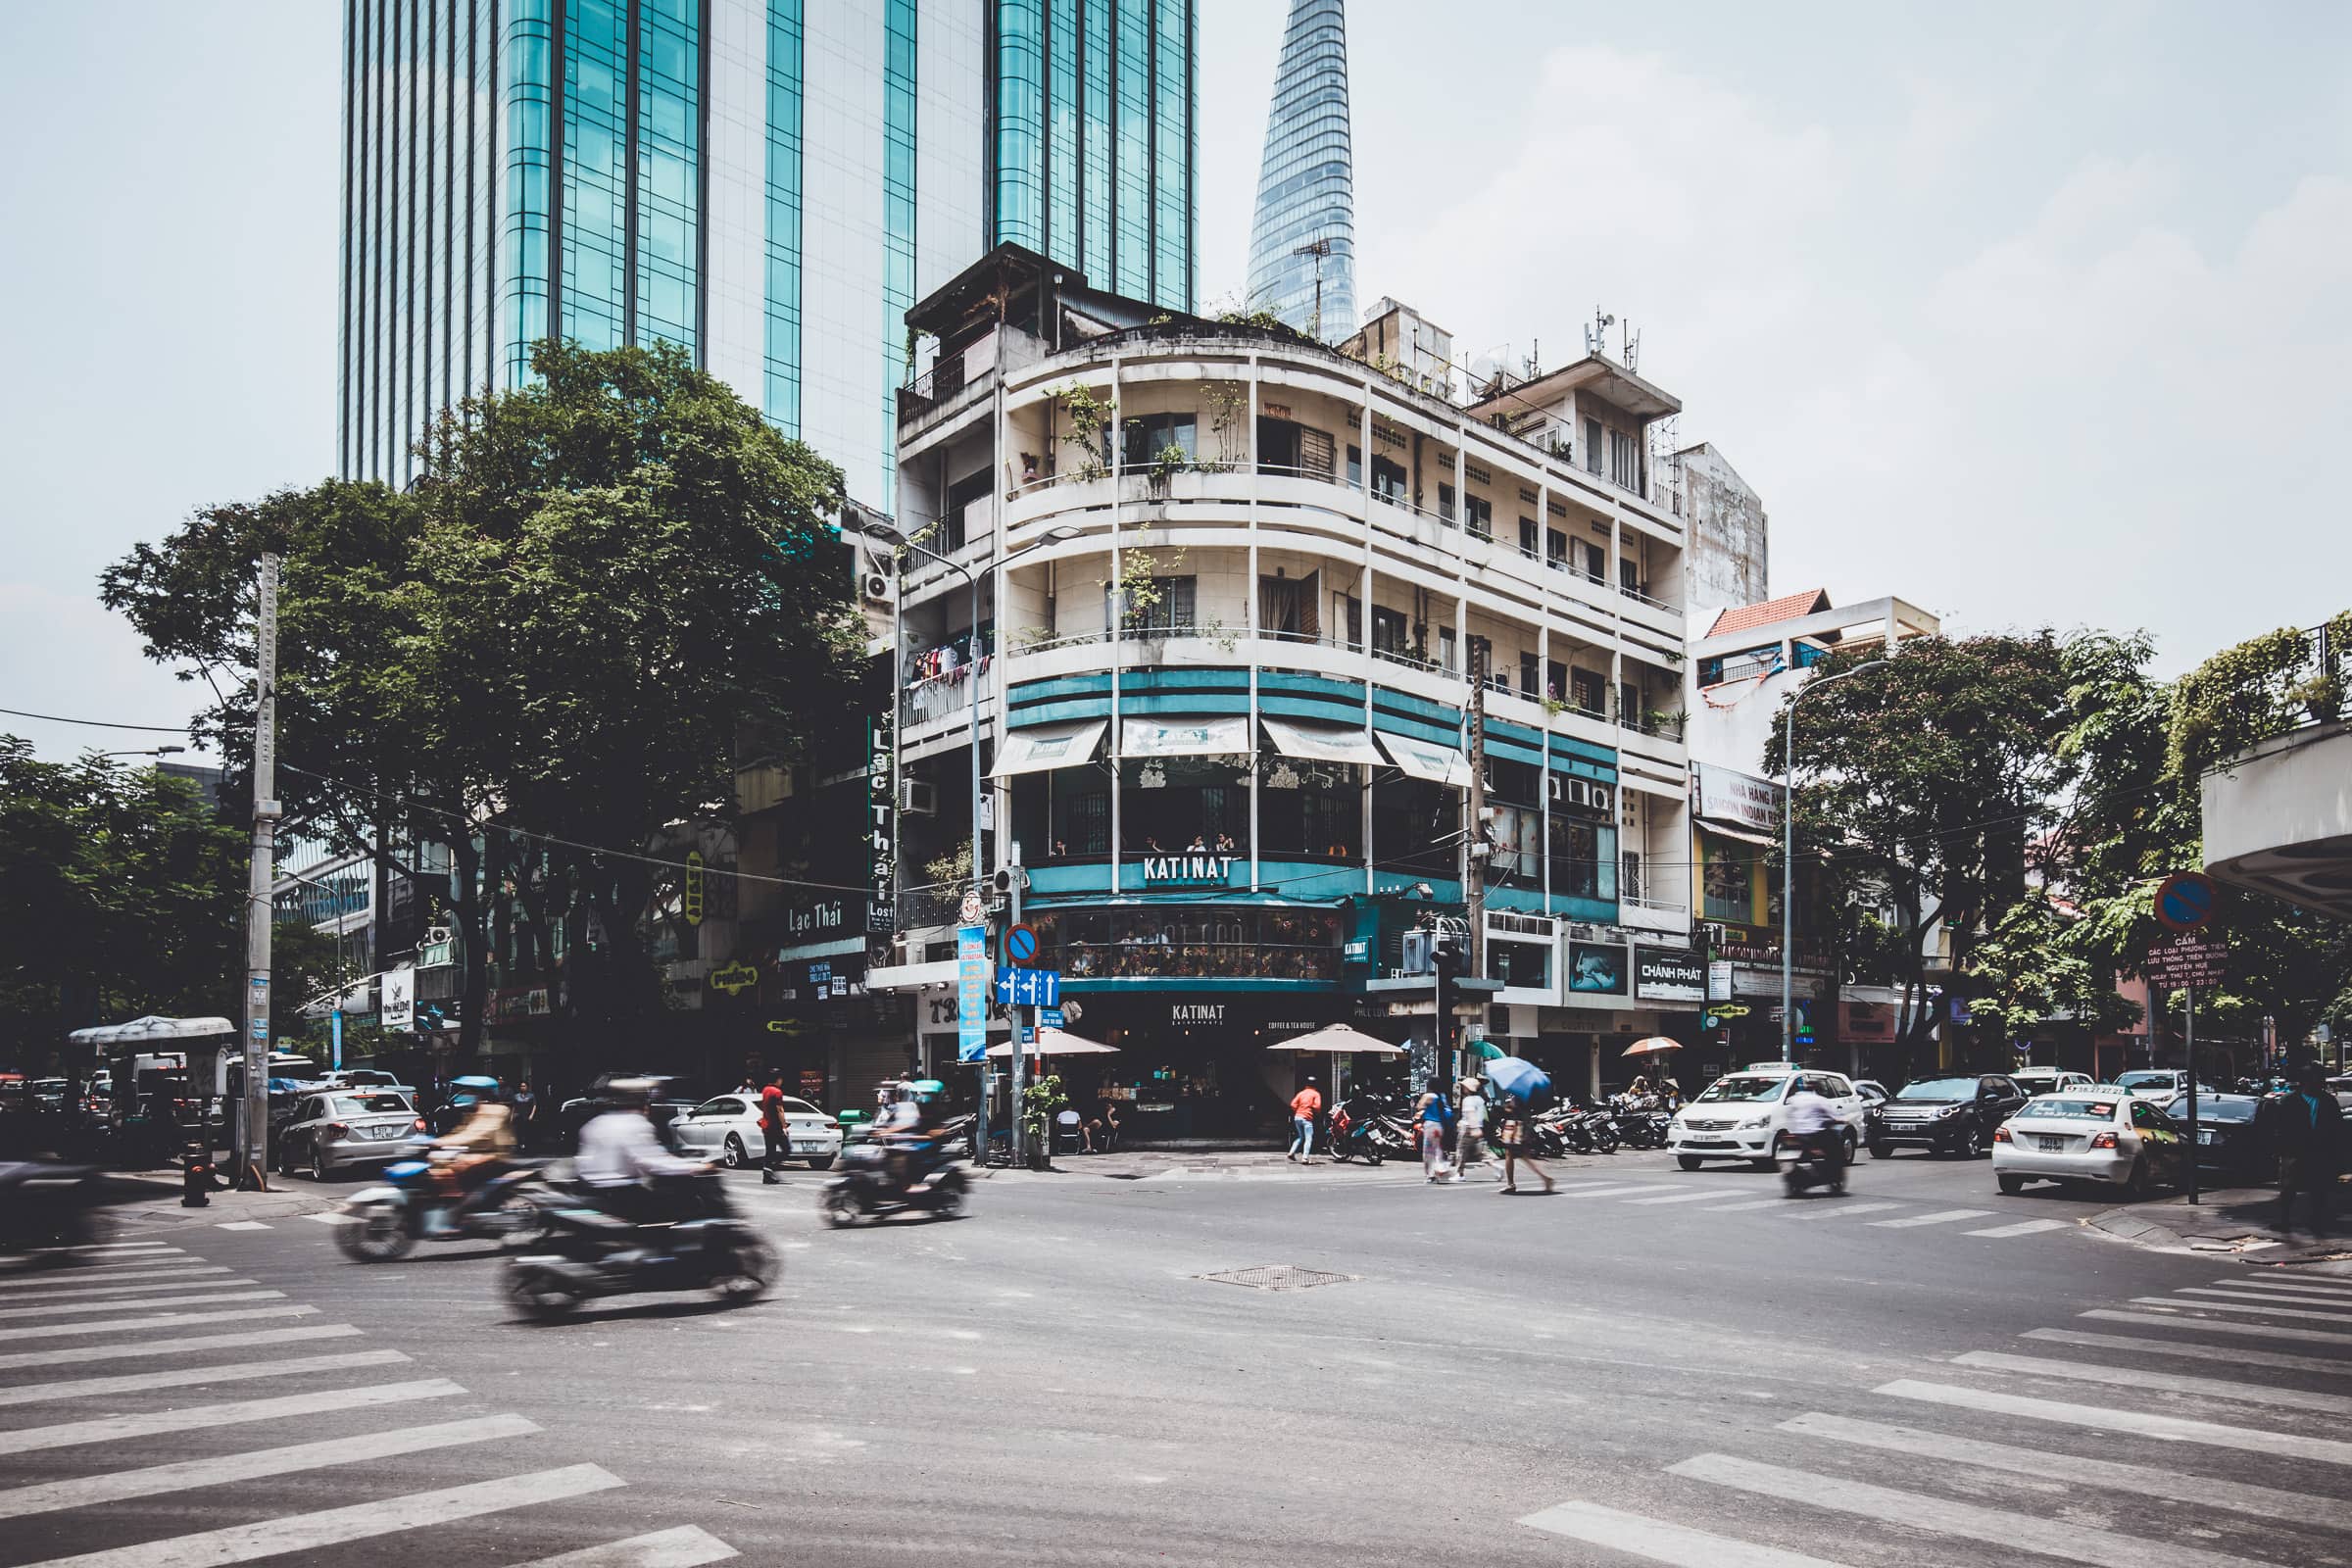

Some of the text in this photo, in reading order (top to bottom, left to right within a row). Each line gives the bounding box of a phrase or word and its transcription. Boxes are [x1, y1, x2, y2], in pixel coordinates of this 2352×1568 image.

[1740, 803, 1767, 822] INDIAN
[1144, 856, 1232, 879] KATINAT
[869, 902, 894, 917] Lost
[789, 909, 810, 938] Lạc
[814, 901, 841, 929] Thái
[2176, 934, 2196, 946] CẤM
[1173, 1004, 1225, 1019] KATINAT
